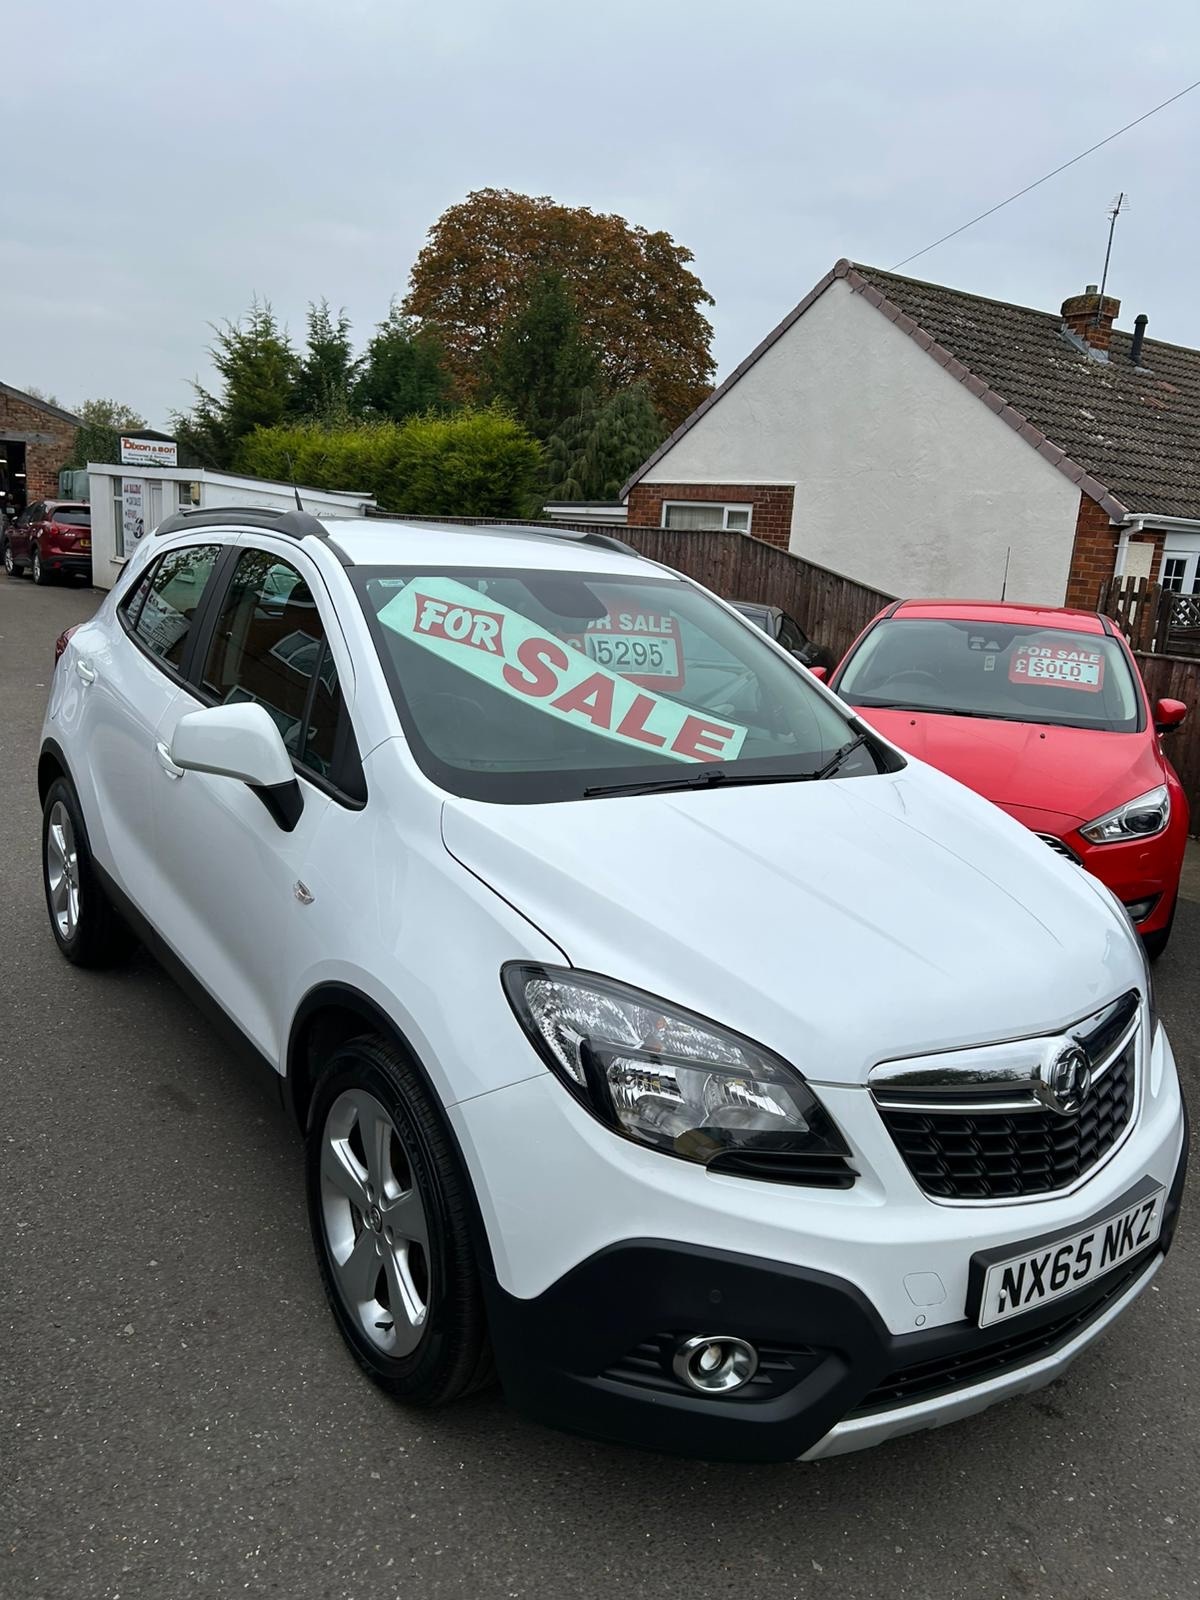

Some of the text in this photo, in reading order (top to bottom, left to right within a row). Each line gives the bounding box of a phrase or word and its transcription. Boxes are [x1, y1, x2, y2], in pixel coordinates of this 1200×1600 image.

[618, 613, 673, 633] SALE
[597, 640, 663, 667] 5295
[1018, 646, 1100, 662] FOR SALE
[1015, 659, 1081, 677] £ SOLD
[419, 600, 735, 763] FOR SALE
[998, 1198, 1157, 1314] NX65 NKZ
